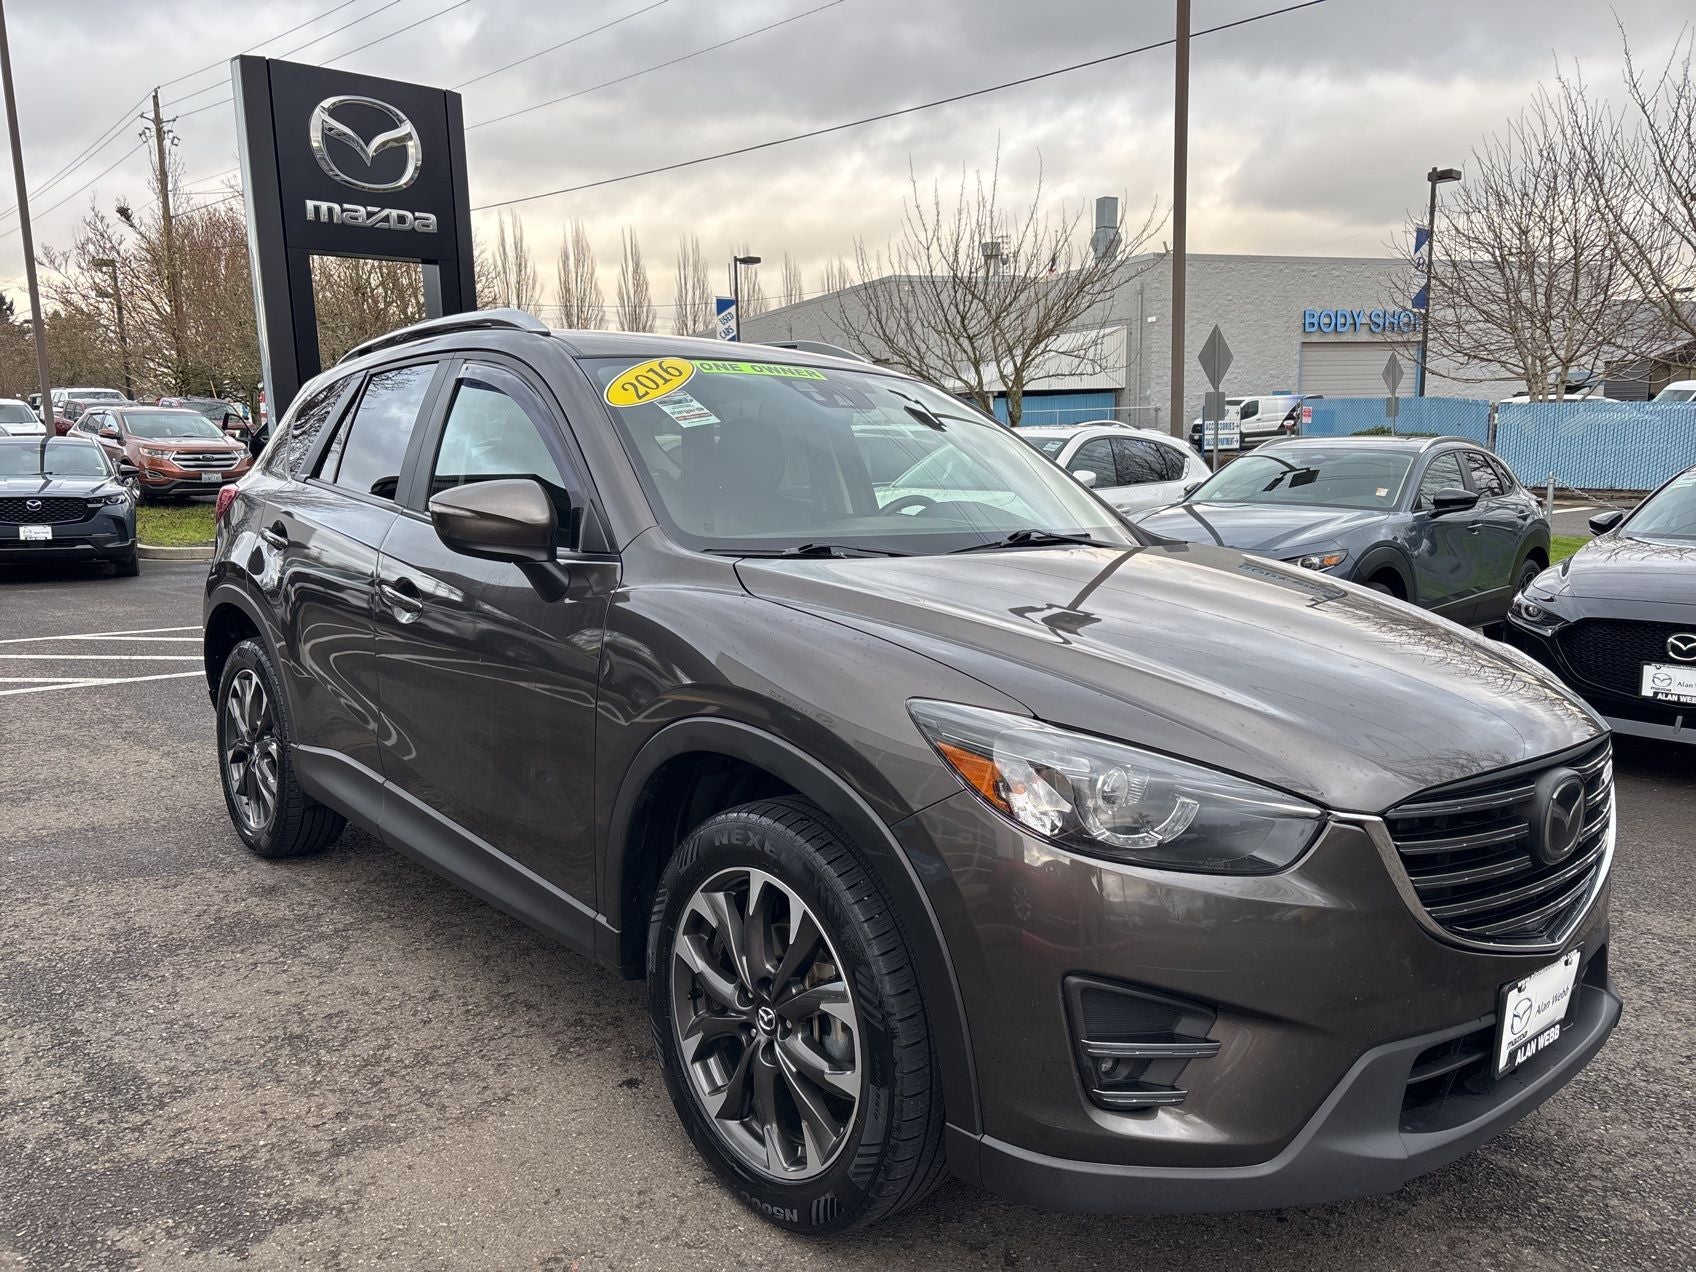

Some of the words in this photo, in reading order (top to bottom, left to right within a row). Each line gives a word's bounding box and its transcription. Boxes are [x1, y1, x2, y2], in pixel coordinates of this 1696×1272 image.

[719, 312, 734, 325] USED
[1303, 308, 1364, 334] BODY
[719, 325, 735, 340] CARS
[700, 363, 743, 372] ONE
[751, 364, 821, 377] OWNER
[622, 361, 683, 400] 2016
[1205, 421, 1235, 431] ACCSORIES
[1656, 692, 1678, 701] ALAN
[1536, 1001, 1551, 1015] Alan
[1551, 986, 1569, 1004] Webb
[1515, 1039, 1537, 1066] ALAN
[1538, 1024, 1560, 1051] WEBB
